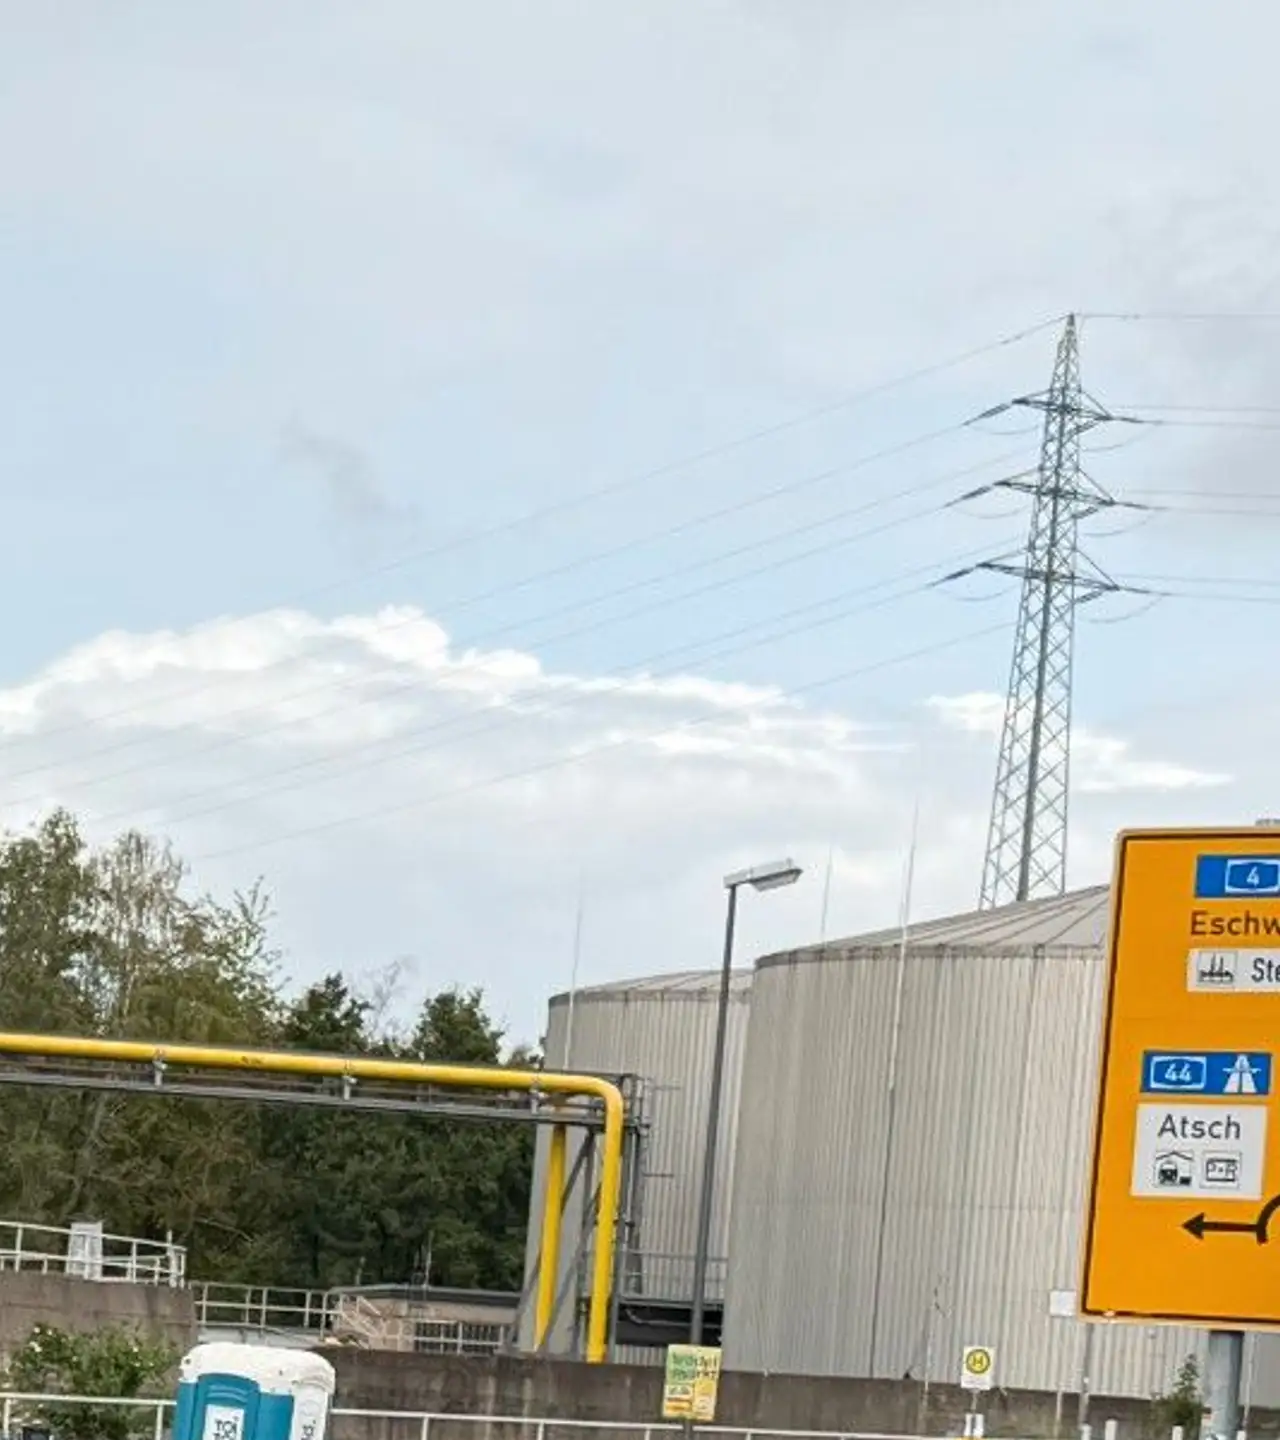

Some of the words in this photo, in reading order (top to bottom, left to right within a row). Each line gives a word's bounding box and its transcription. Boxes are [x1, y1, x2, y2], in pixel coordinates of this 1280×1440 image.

[1246, 866, 1260, 887] 4
[1164, 1062, 1193, 1083] 44
[1157, 1113, 1241, 1140] Atsch
